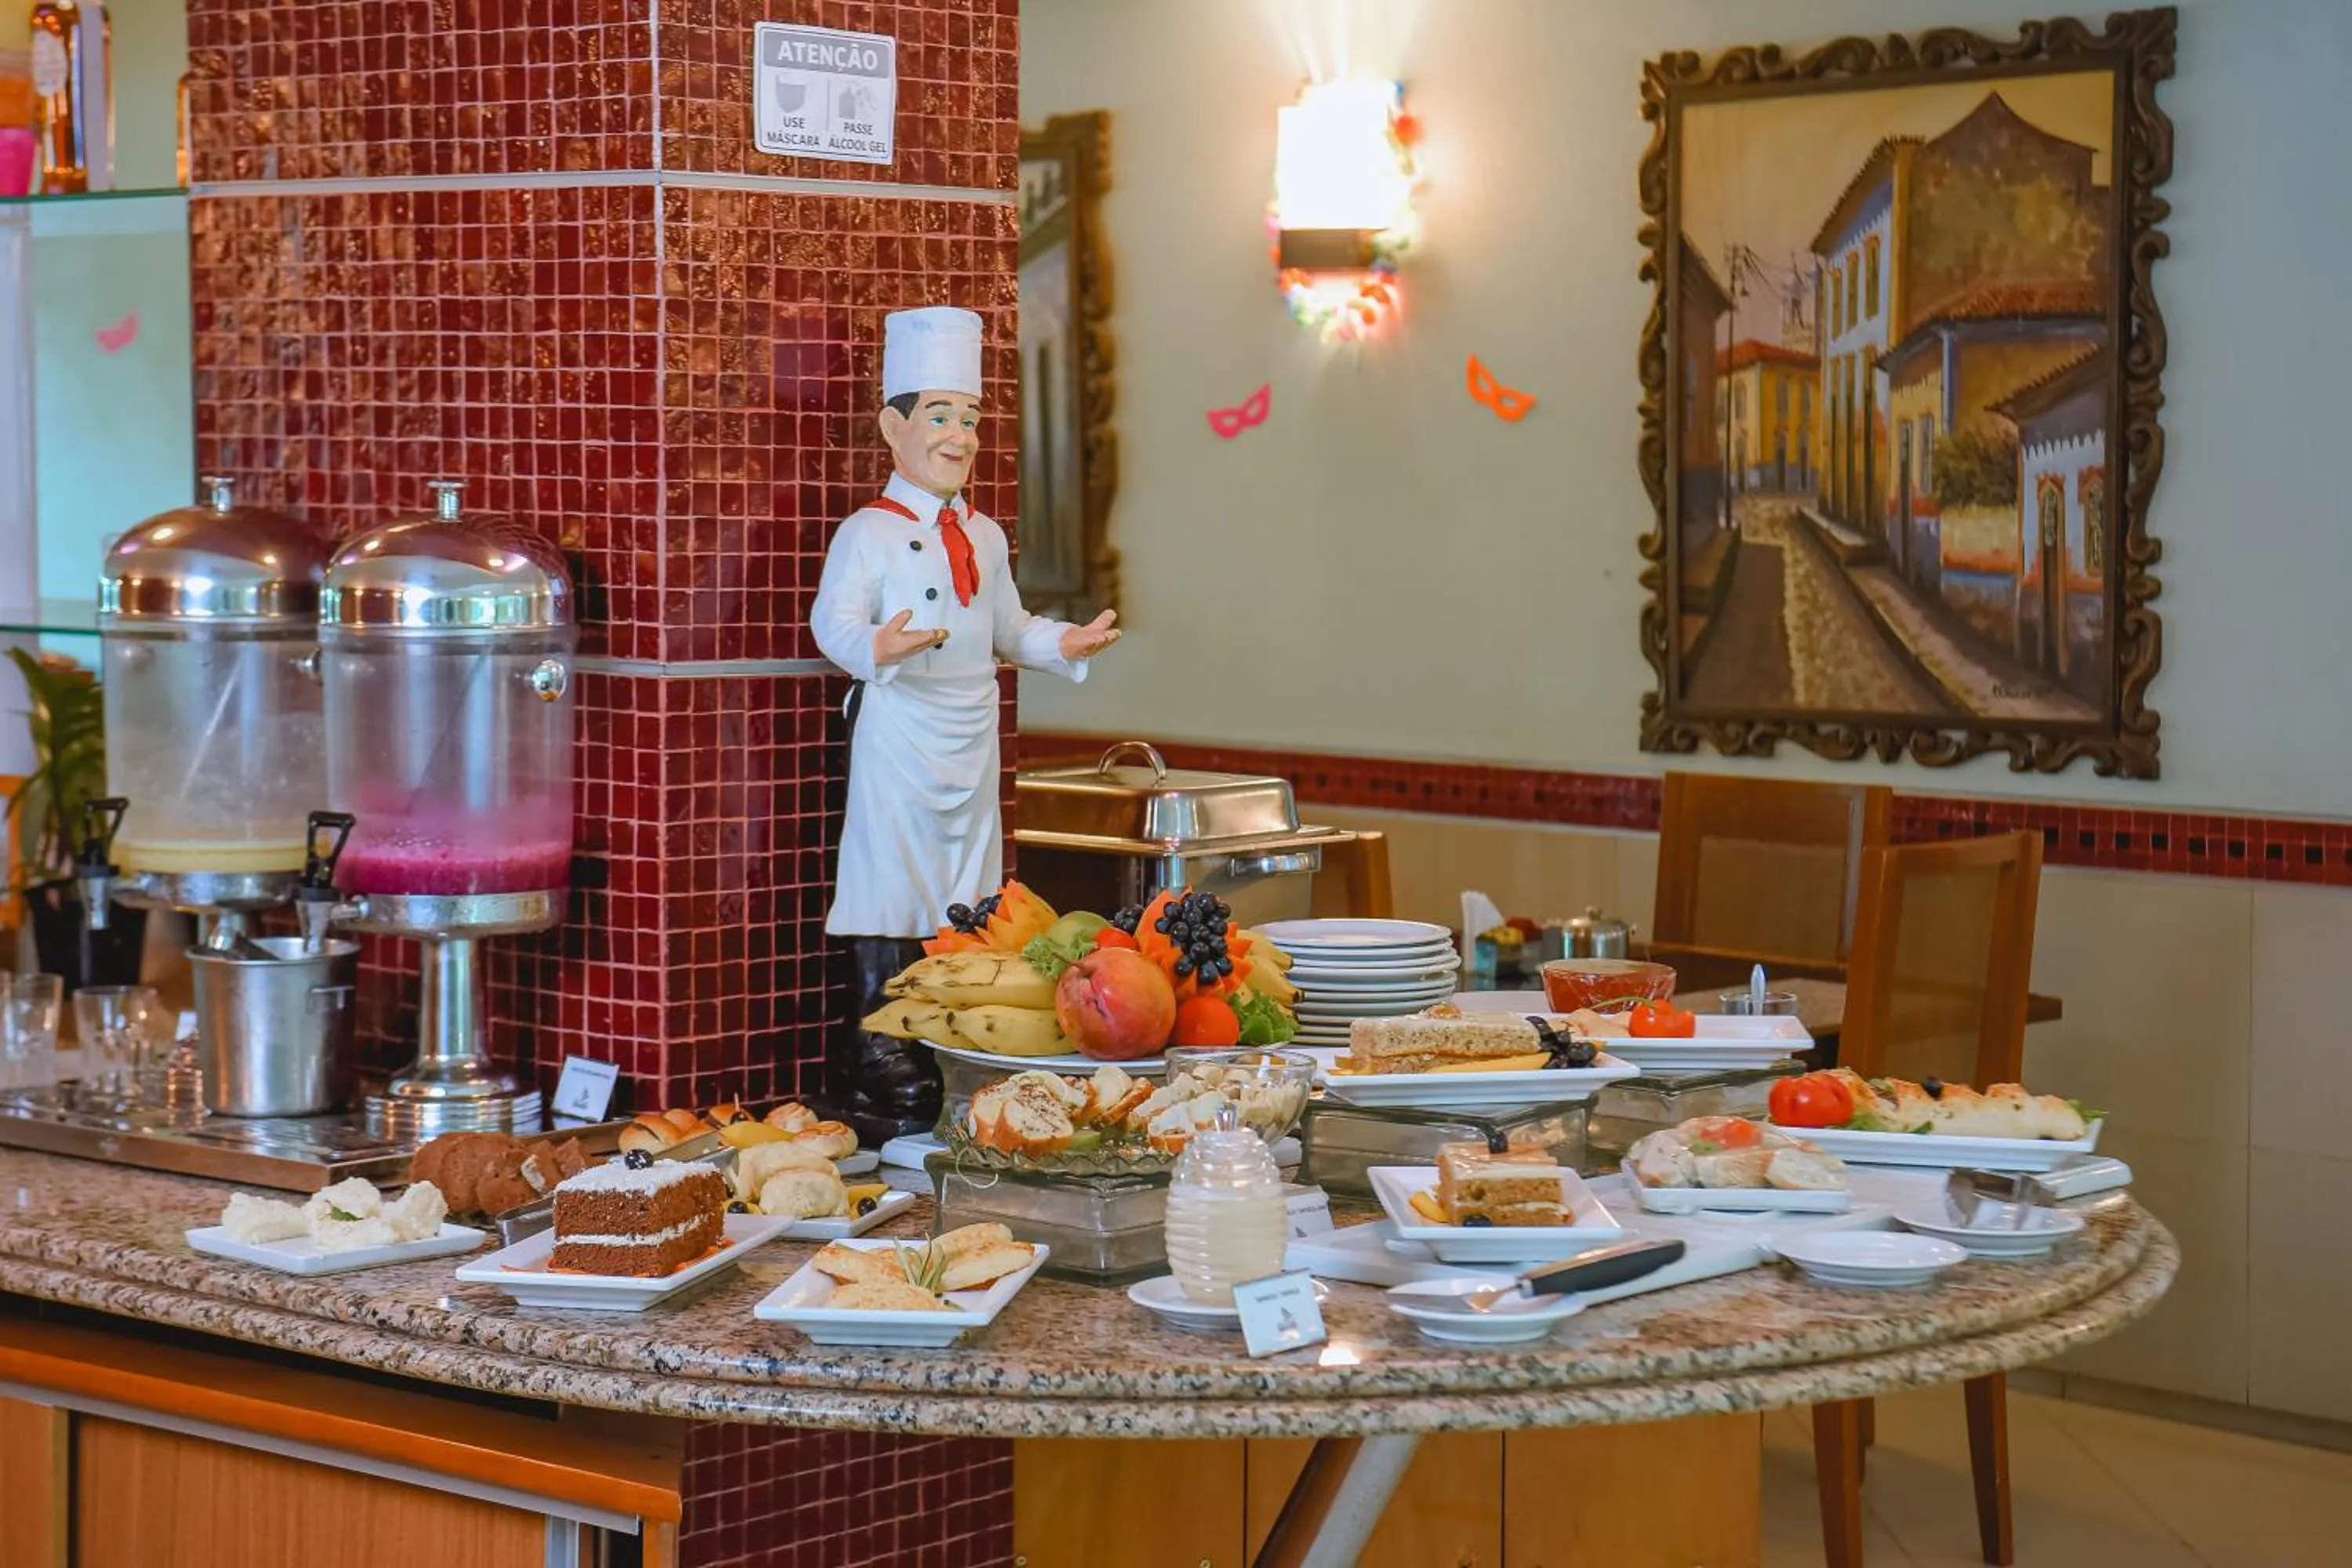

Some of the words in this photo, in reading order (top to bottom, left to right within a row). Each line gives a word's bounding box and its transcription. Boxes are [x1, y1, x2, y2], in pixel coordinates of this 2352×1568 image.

[777, 40, 878, 71] ATENÇÃO
[783, 116, 806, 129] USE
[844, 122, 873, 136] PASSE
[768, 130, 820, 147] MÁSCARA
[829, 134, 867, 151] ÁLCOOL
[868, 141, 887, 153] GEL
